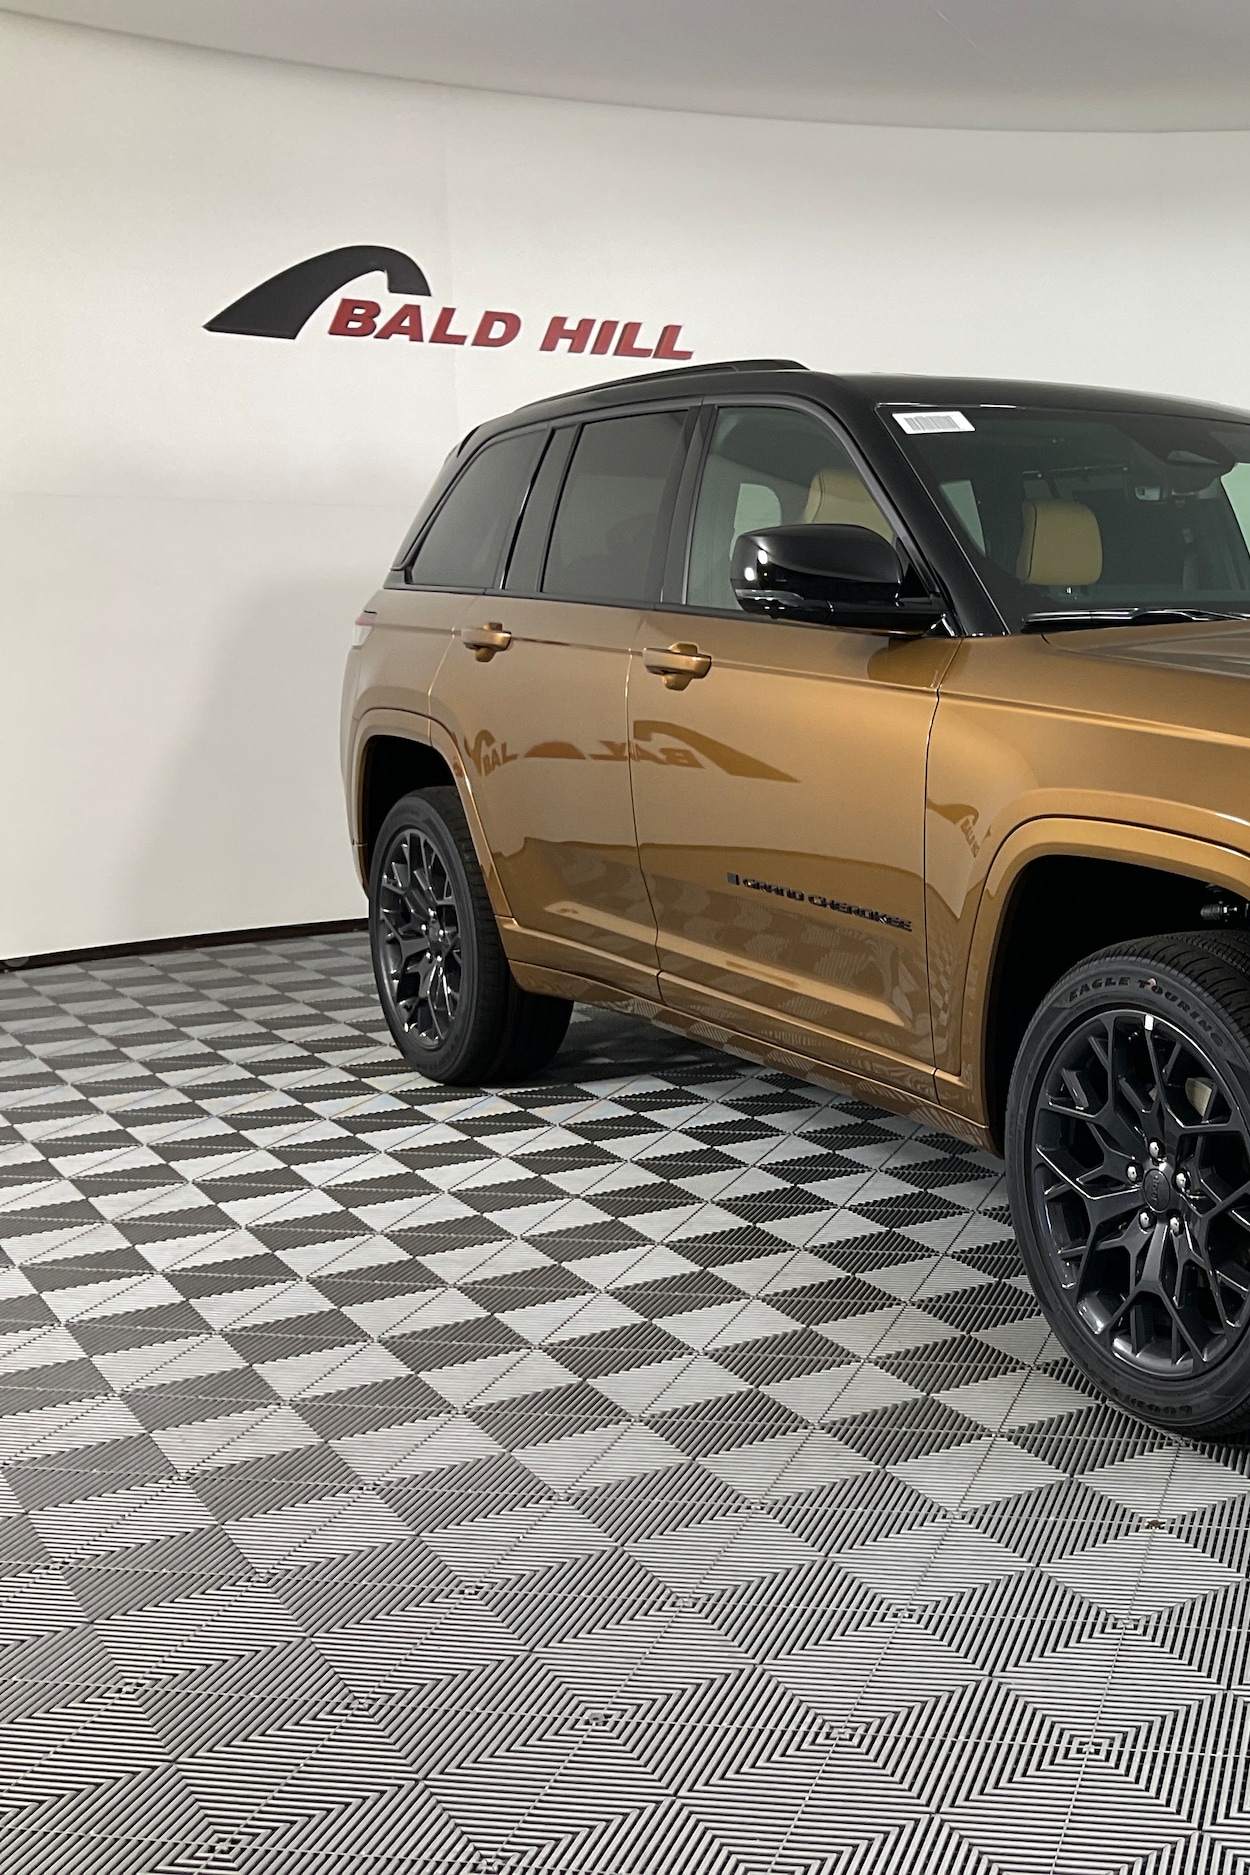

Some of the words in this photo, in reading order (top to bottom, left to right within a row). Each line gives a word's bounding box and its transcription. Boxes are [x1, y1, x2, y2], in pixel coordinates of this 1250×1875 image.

[328, 298, 522, 348] BALD
[539, 316, 695, 361] HILL
[743, 877, 804, 902] GRAND
[808, 894, 913, 932] CHEROKEE
[1068, 976, 1131, 1002] EAGLE
[1138, 979, 1225, 1048] TOURING
